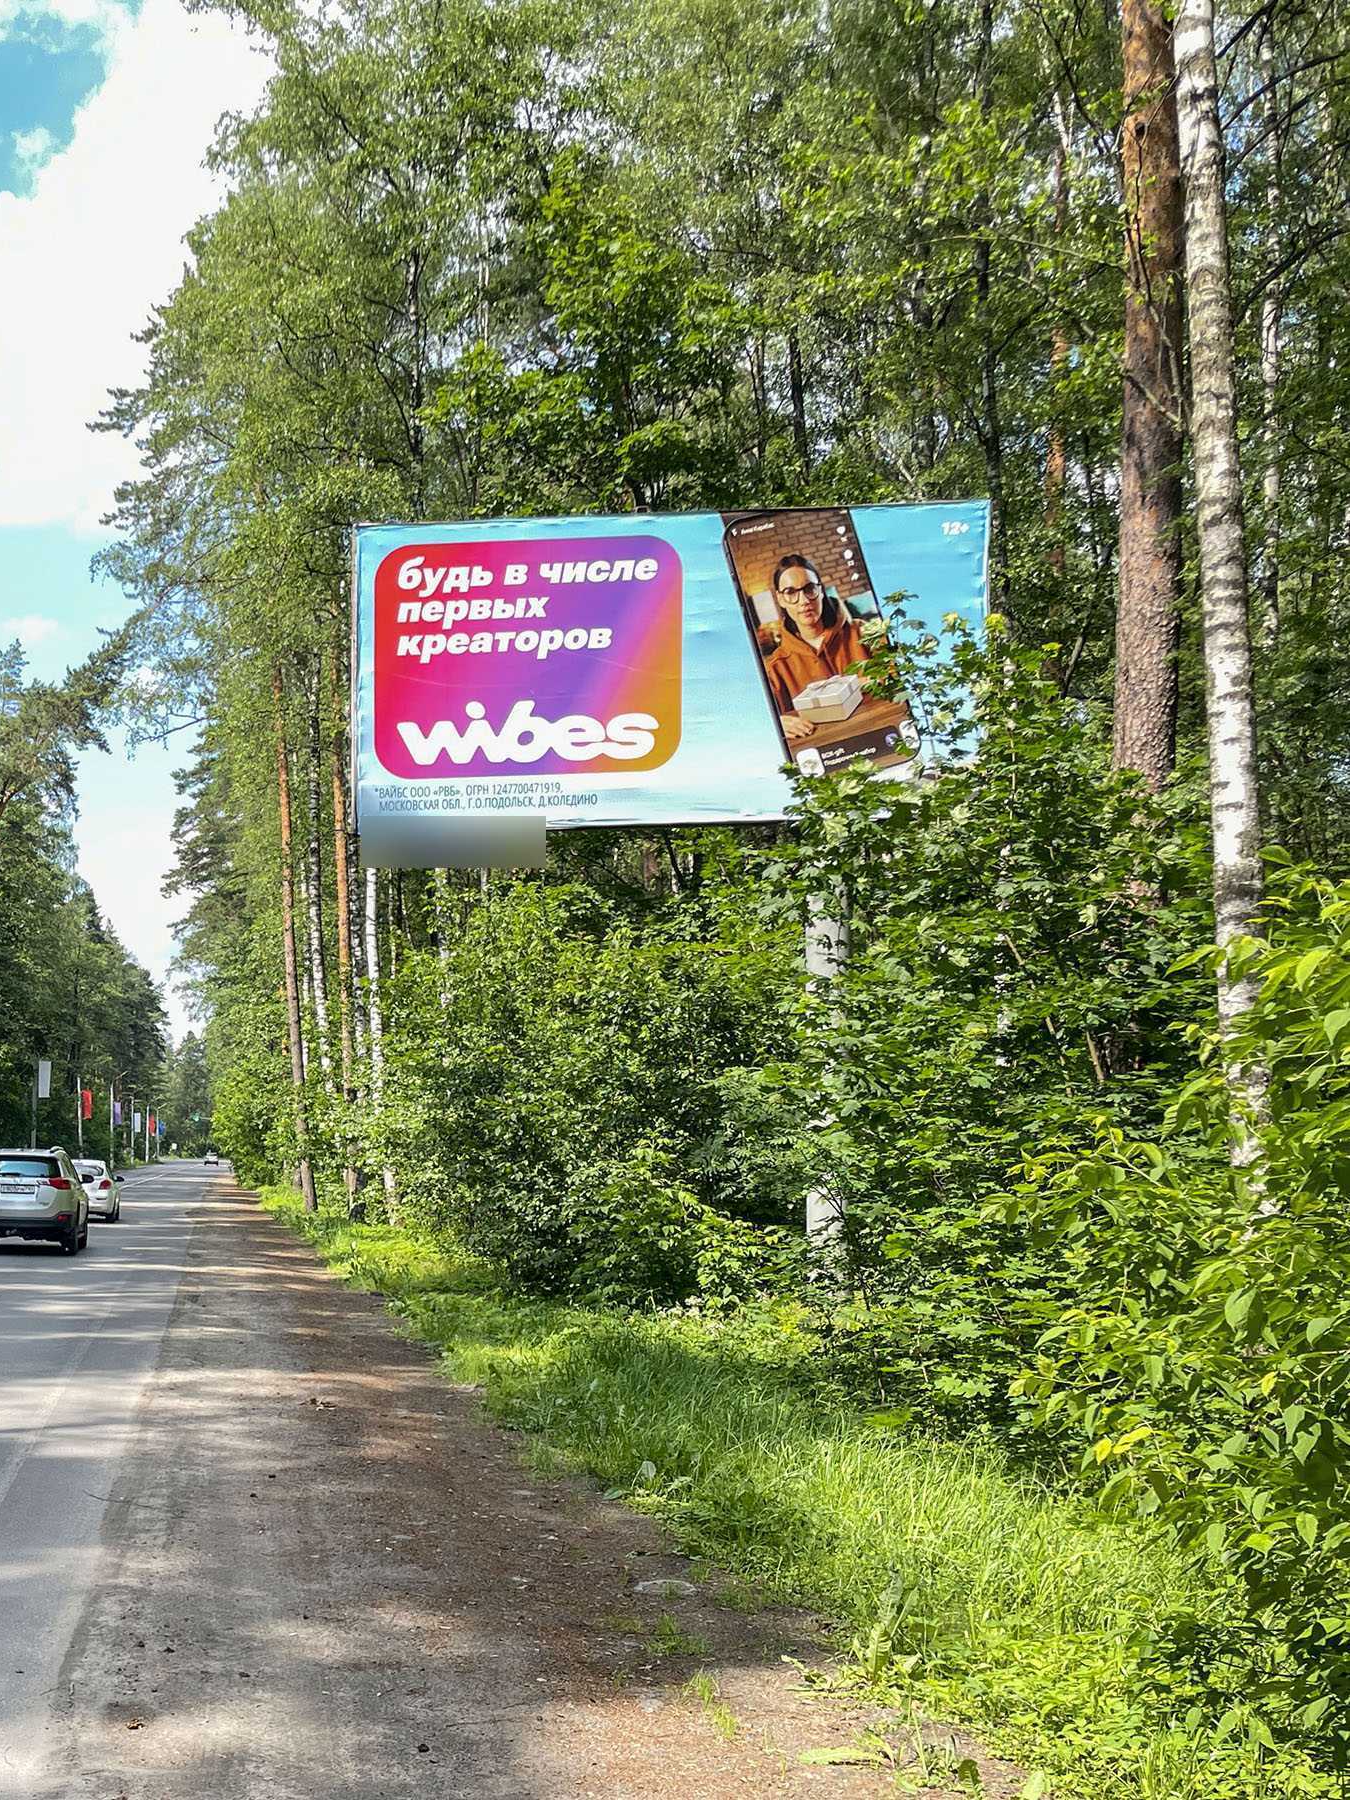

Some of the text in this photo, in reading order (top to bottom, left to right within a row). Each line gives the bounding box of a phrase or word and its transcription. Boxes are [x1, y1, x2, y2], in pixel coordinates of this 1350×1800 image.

[397, 556, 659, 597] будь в числе
[396, 597, 550, 630] первых
[396, 627, 613, 664] креаторов
[396, 700, 660, 765] wibes
[379, 799, 439, 812] МОСКОВСКАЯ
[538, 793, 598, 808] Д.КОЛЕДИНО
[410, 786, 431, 798] ООО
[465, 784, 489, 796] ОГРН
[492, 782, 563, 795] 1247700471919,
